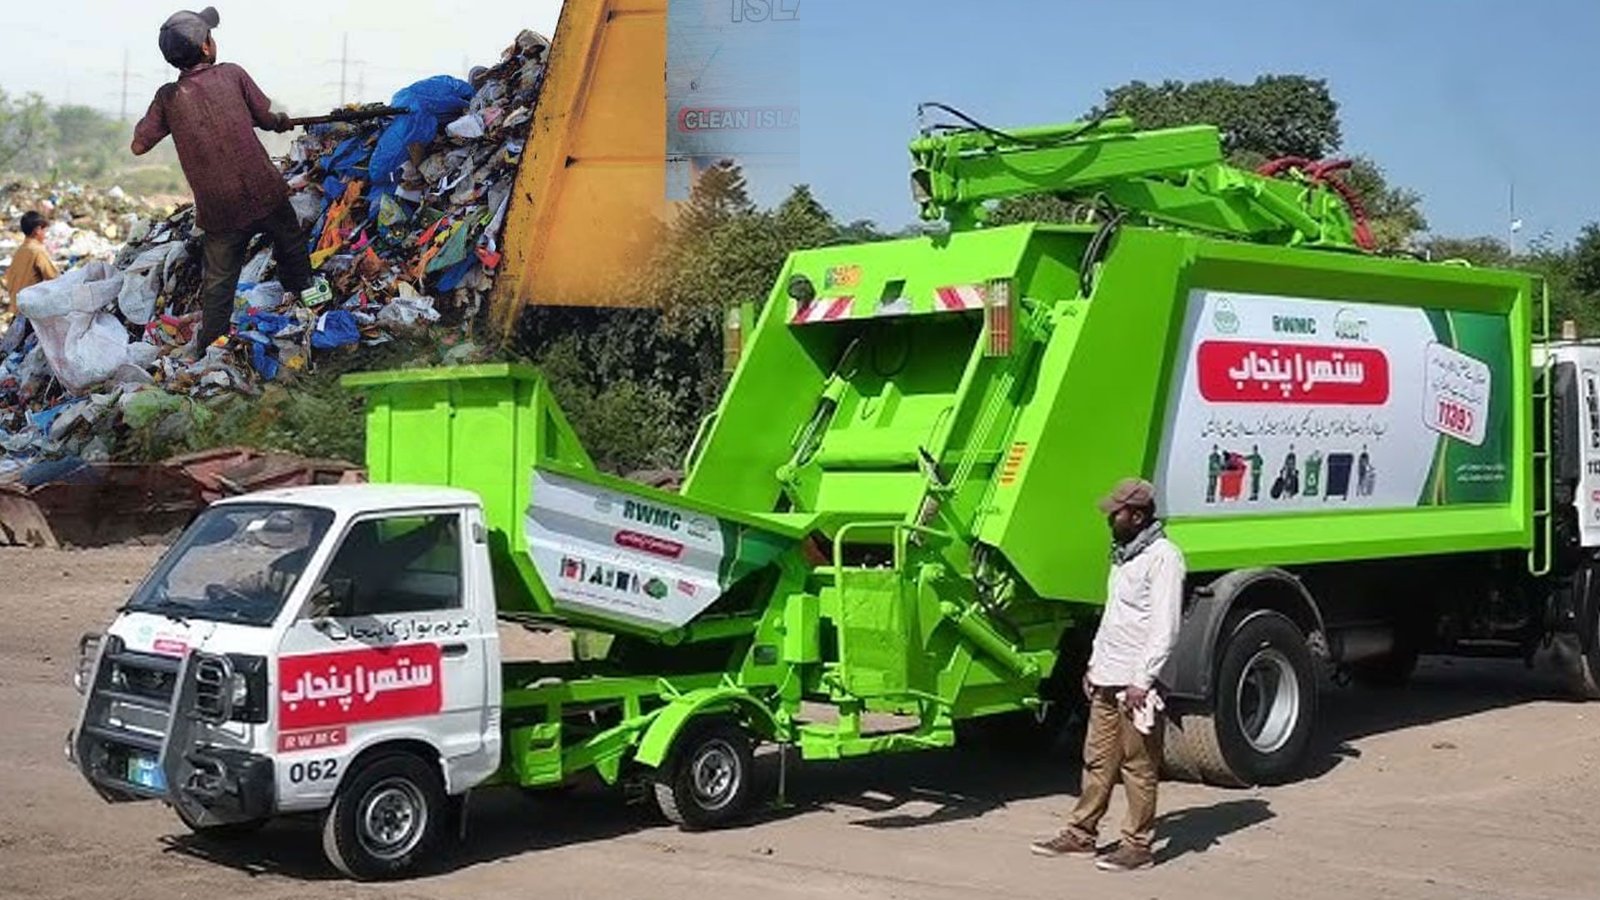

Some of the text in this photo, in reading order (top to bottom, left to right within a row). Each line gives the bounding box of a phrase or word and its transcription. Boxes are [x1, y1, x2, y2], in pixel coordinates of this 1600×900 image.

[685, 110, 749, 130] CLEAN
[1272, 315, 1317, 335] RWMC
[1228, 349, 1293, 398] پنجاب
[623, 500, 682, 531] RWMC
[281, 665, 353, 711] پنجاب
[290, 759, 338, 783] 062
